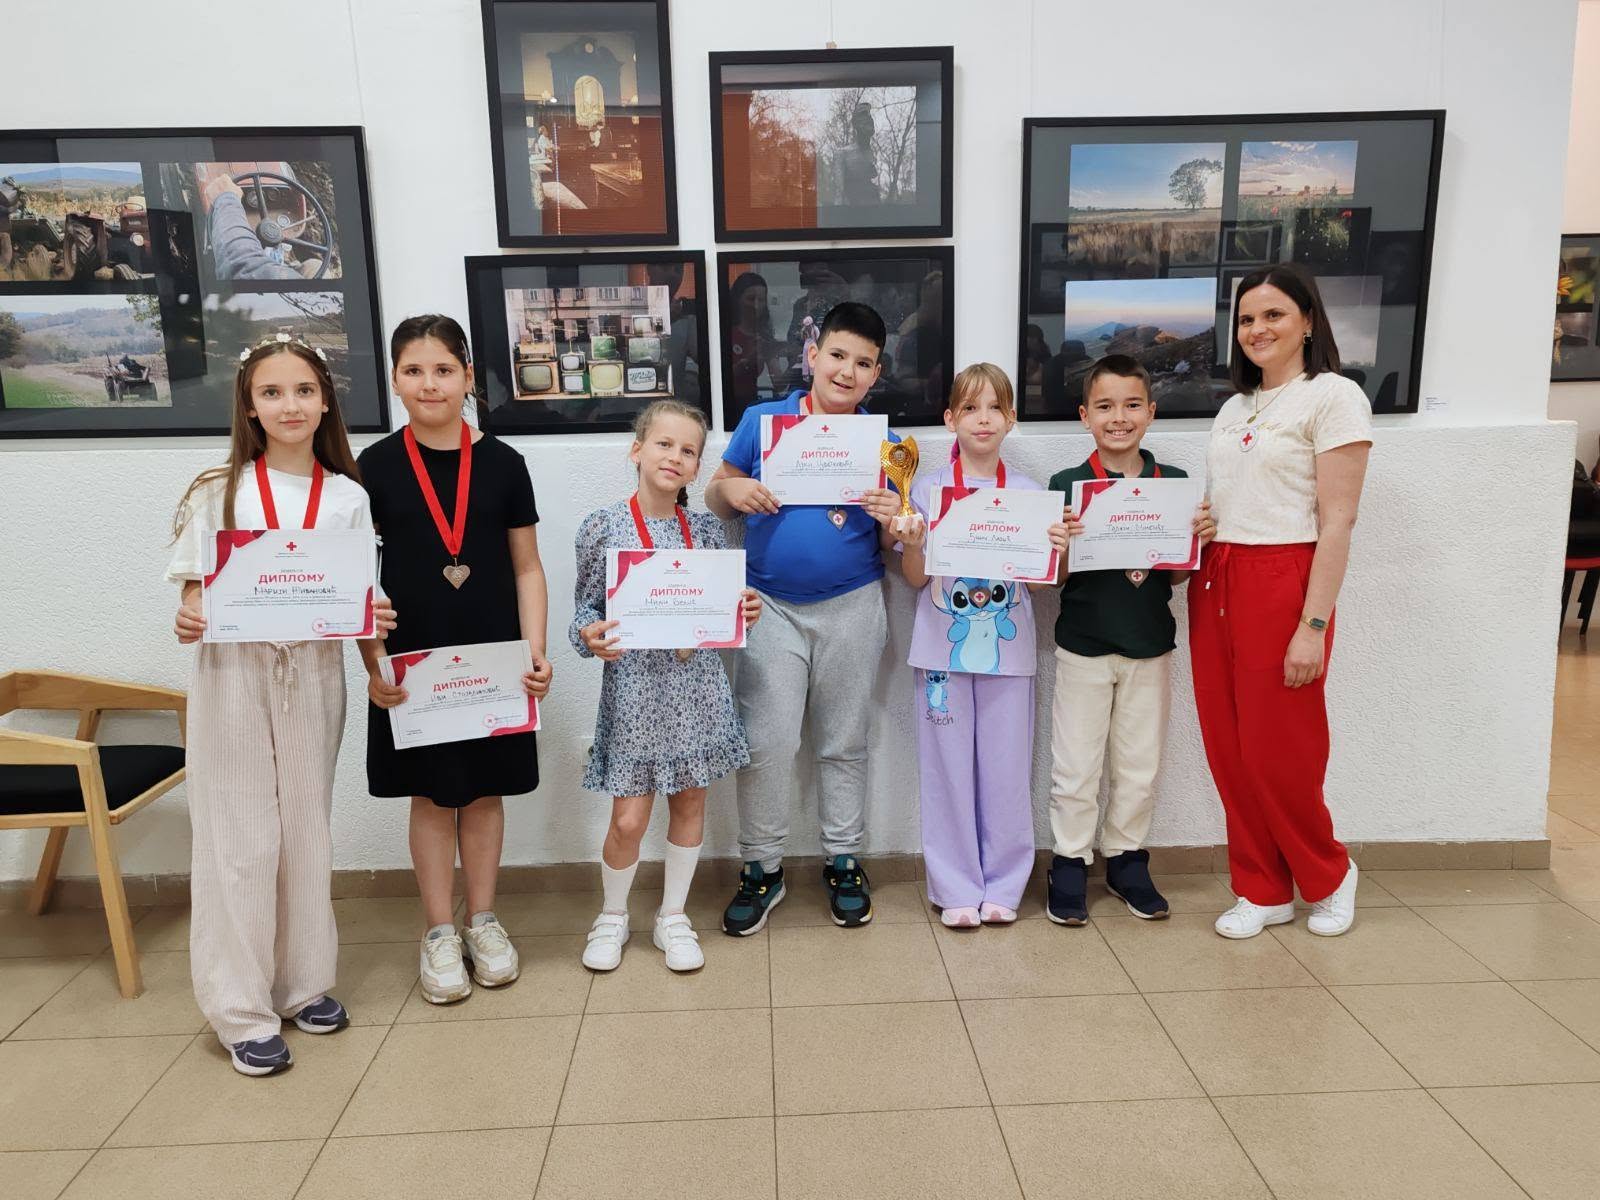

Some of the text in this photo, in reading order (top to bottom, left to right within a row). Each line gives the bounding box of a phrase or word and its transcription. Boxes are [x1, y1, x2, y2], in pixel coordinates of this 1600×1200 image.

[801, 450, 850, 459] ДИПЛОМУ
[1109, 513, 1161, 523] ДИПЛОМУ
[969, 523, 1021, 533] ДИПЛОМУ
[258, 573, 326, 584] ДИПЛОМУ
[650, 588, 704, 597] ДИПЛОМУ
[433, 676, 490, 692] ДИПЛОМУ
